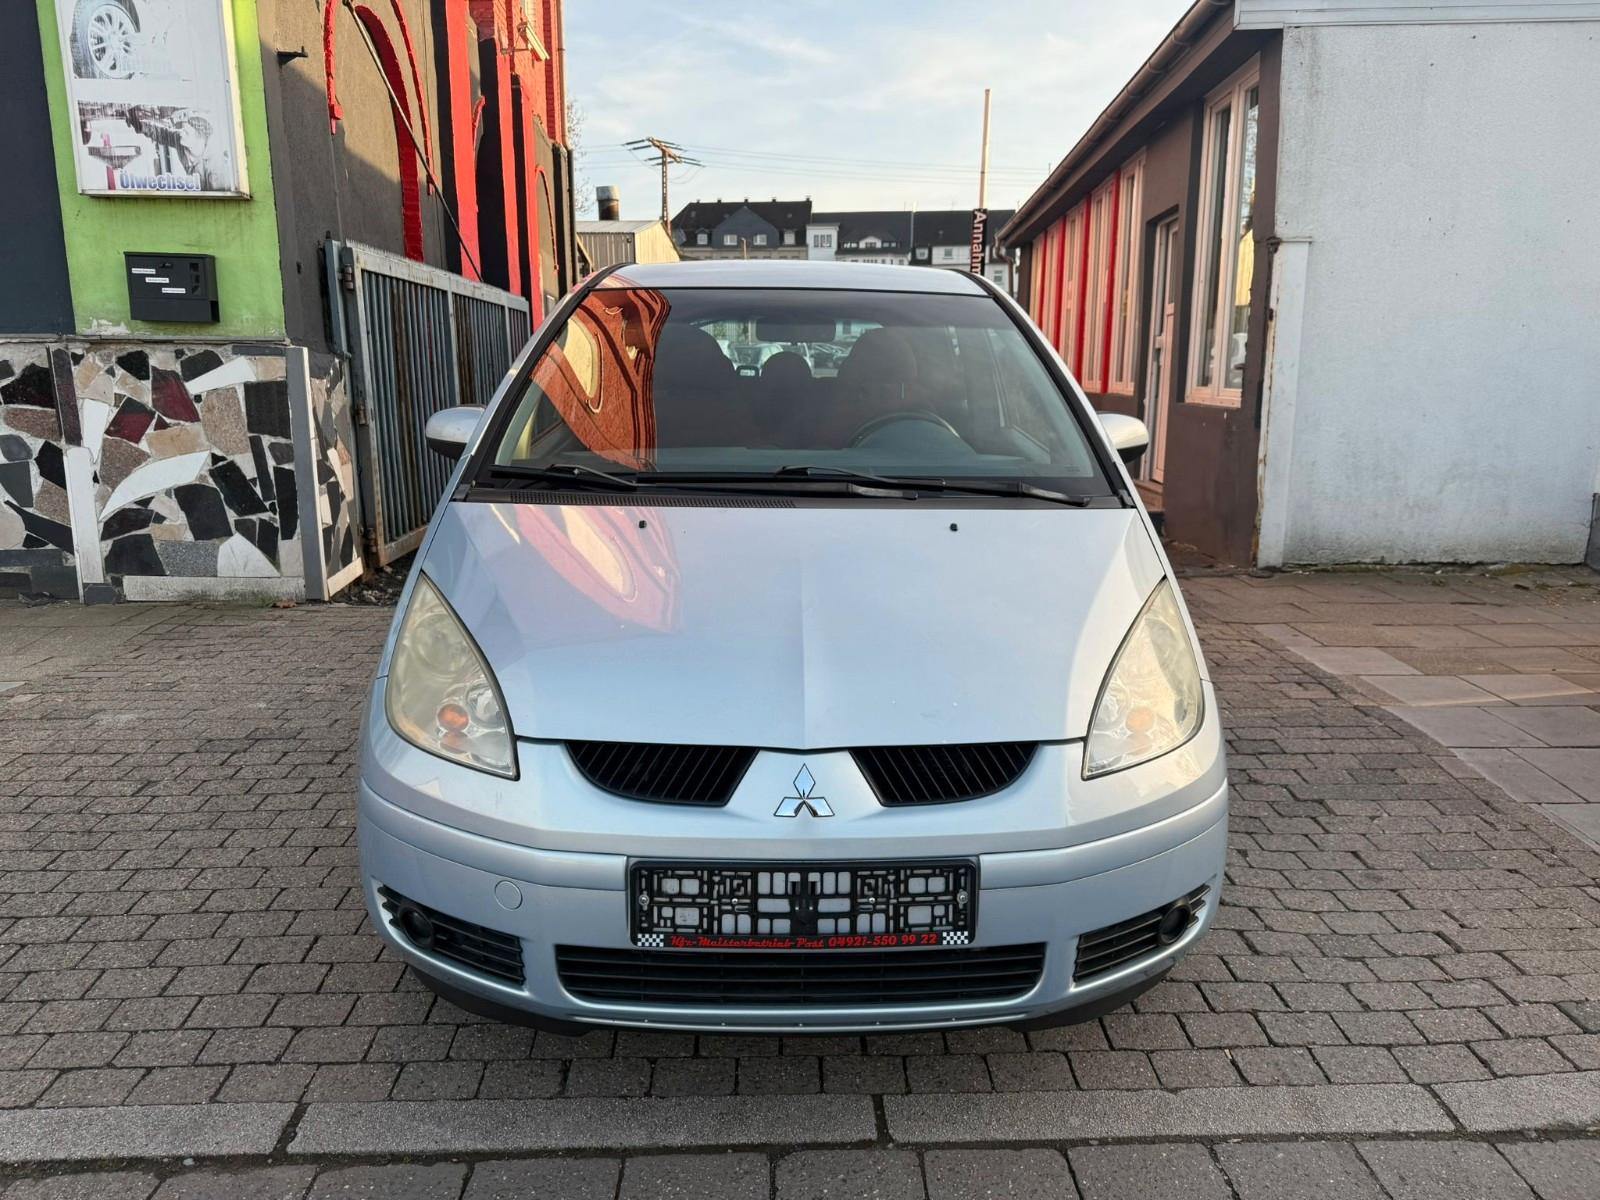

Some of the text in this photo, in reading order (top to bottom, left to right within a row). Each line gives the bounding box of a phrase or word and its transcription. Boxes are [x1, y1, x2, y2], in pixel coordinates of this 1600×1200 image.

[120, 169, 201, 190] Ölwechsel
[901, 933, 916, 945] 99
[920, 933, 938, 945] 22
